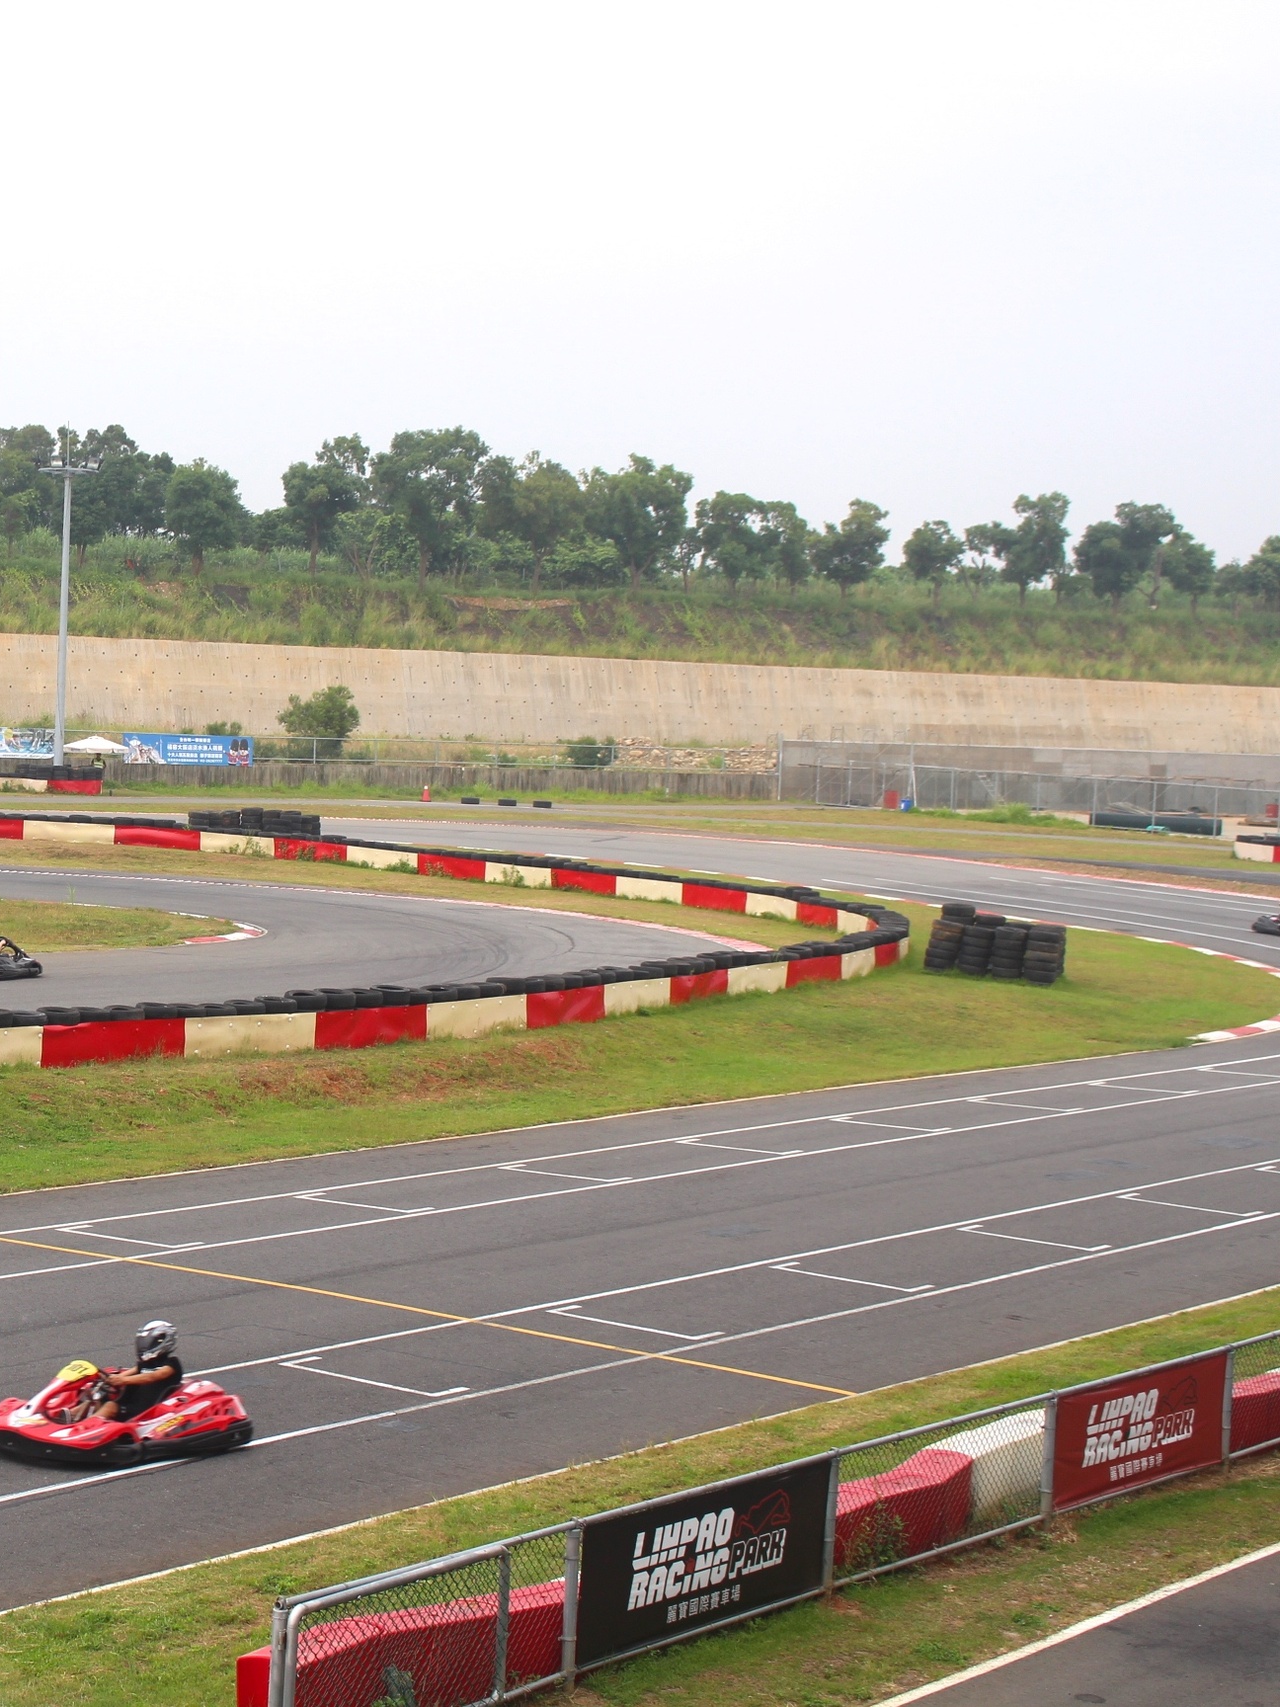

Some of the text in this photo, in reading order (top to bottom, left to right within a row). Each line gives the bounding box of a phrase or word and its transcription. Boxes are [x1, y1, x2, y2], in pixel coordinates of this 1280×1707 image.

[1082, 1409, 1194, 1468] RACING PARK
[1086, 1388, 1159, 1436] LIHPAO
[627, 1528, 786, 1611] RACING PARK
[632, 1507, 736, 1572] LIHPAO
